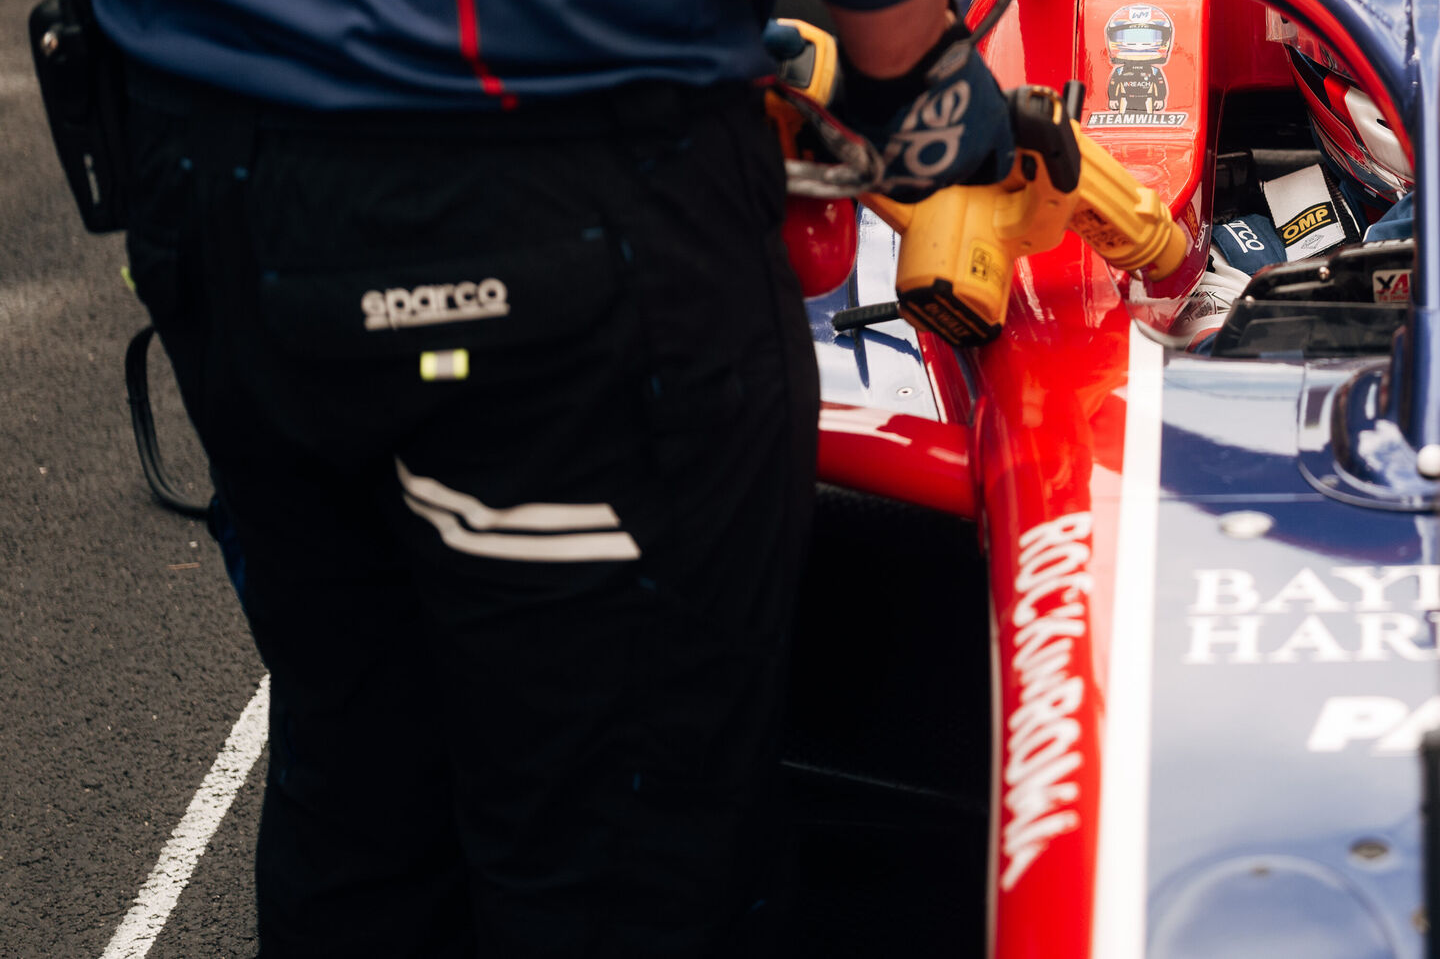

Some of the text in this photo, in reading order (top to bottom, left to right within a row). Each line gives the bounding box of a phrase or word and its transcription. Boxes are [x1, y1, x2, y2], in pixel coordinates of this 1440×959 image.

[1089, 114, 1185, 125] #TEAMWILL37
[1283, 208, 1329, 239] OMP
[361, 277, 510, 330] sparco
